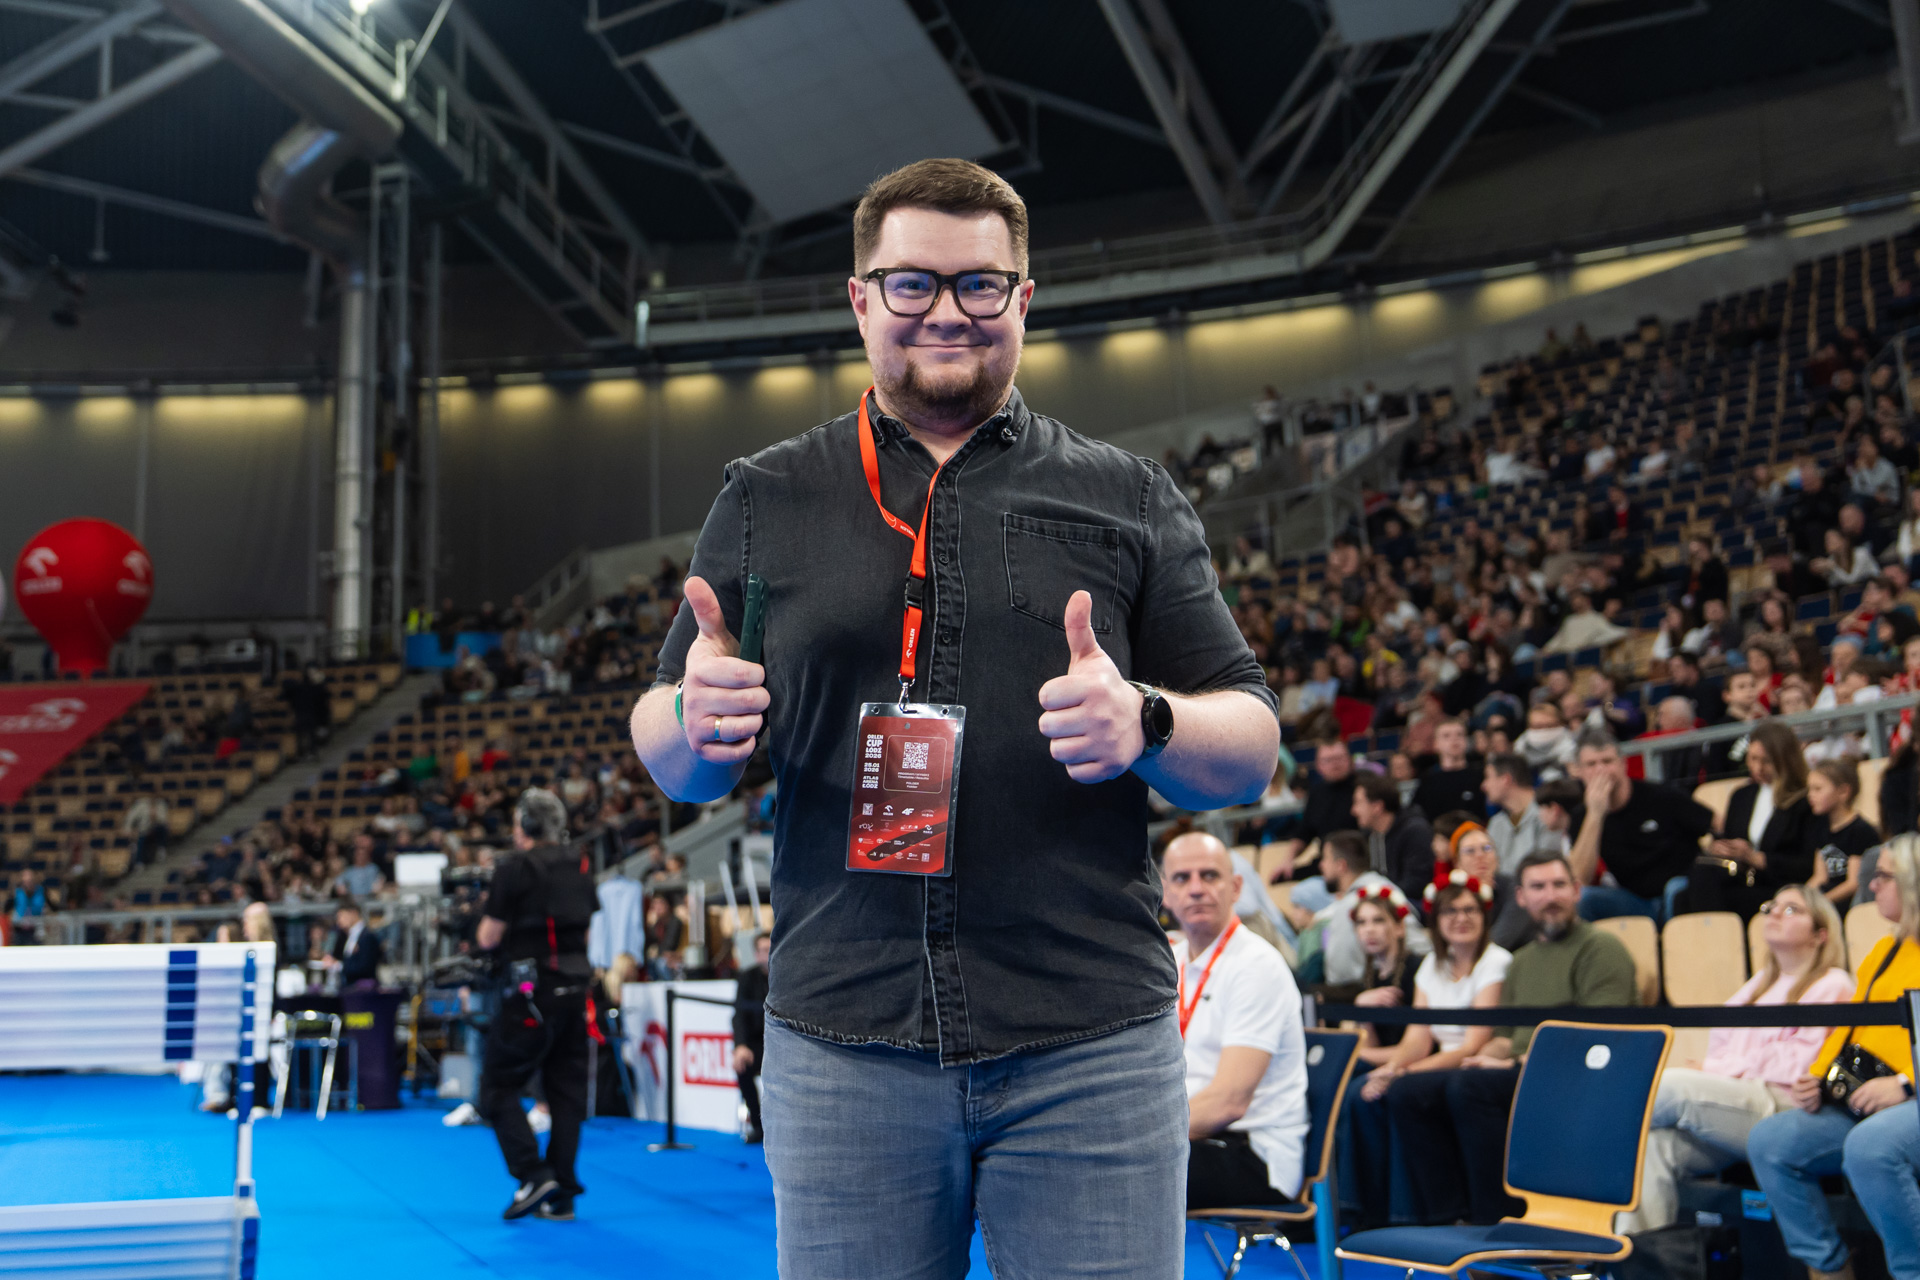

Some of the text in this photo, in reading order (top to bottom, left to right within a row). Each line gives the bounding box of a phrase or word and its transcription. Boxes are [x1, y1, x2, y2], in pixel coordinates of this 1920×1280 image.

[908, 628, 916, 648] ORLEN
[866, 739, 883, 747] CUP
[902, 808, 915, 816] 4F
